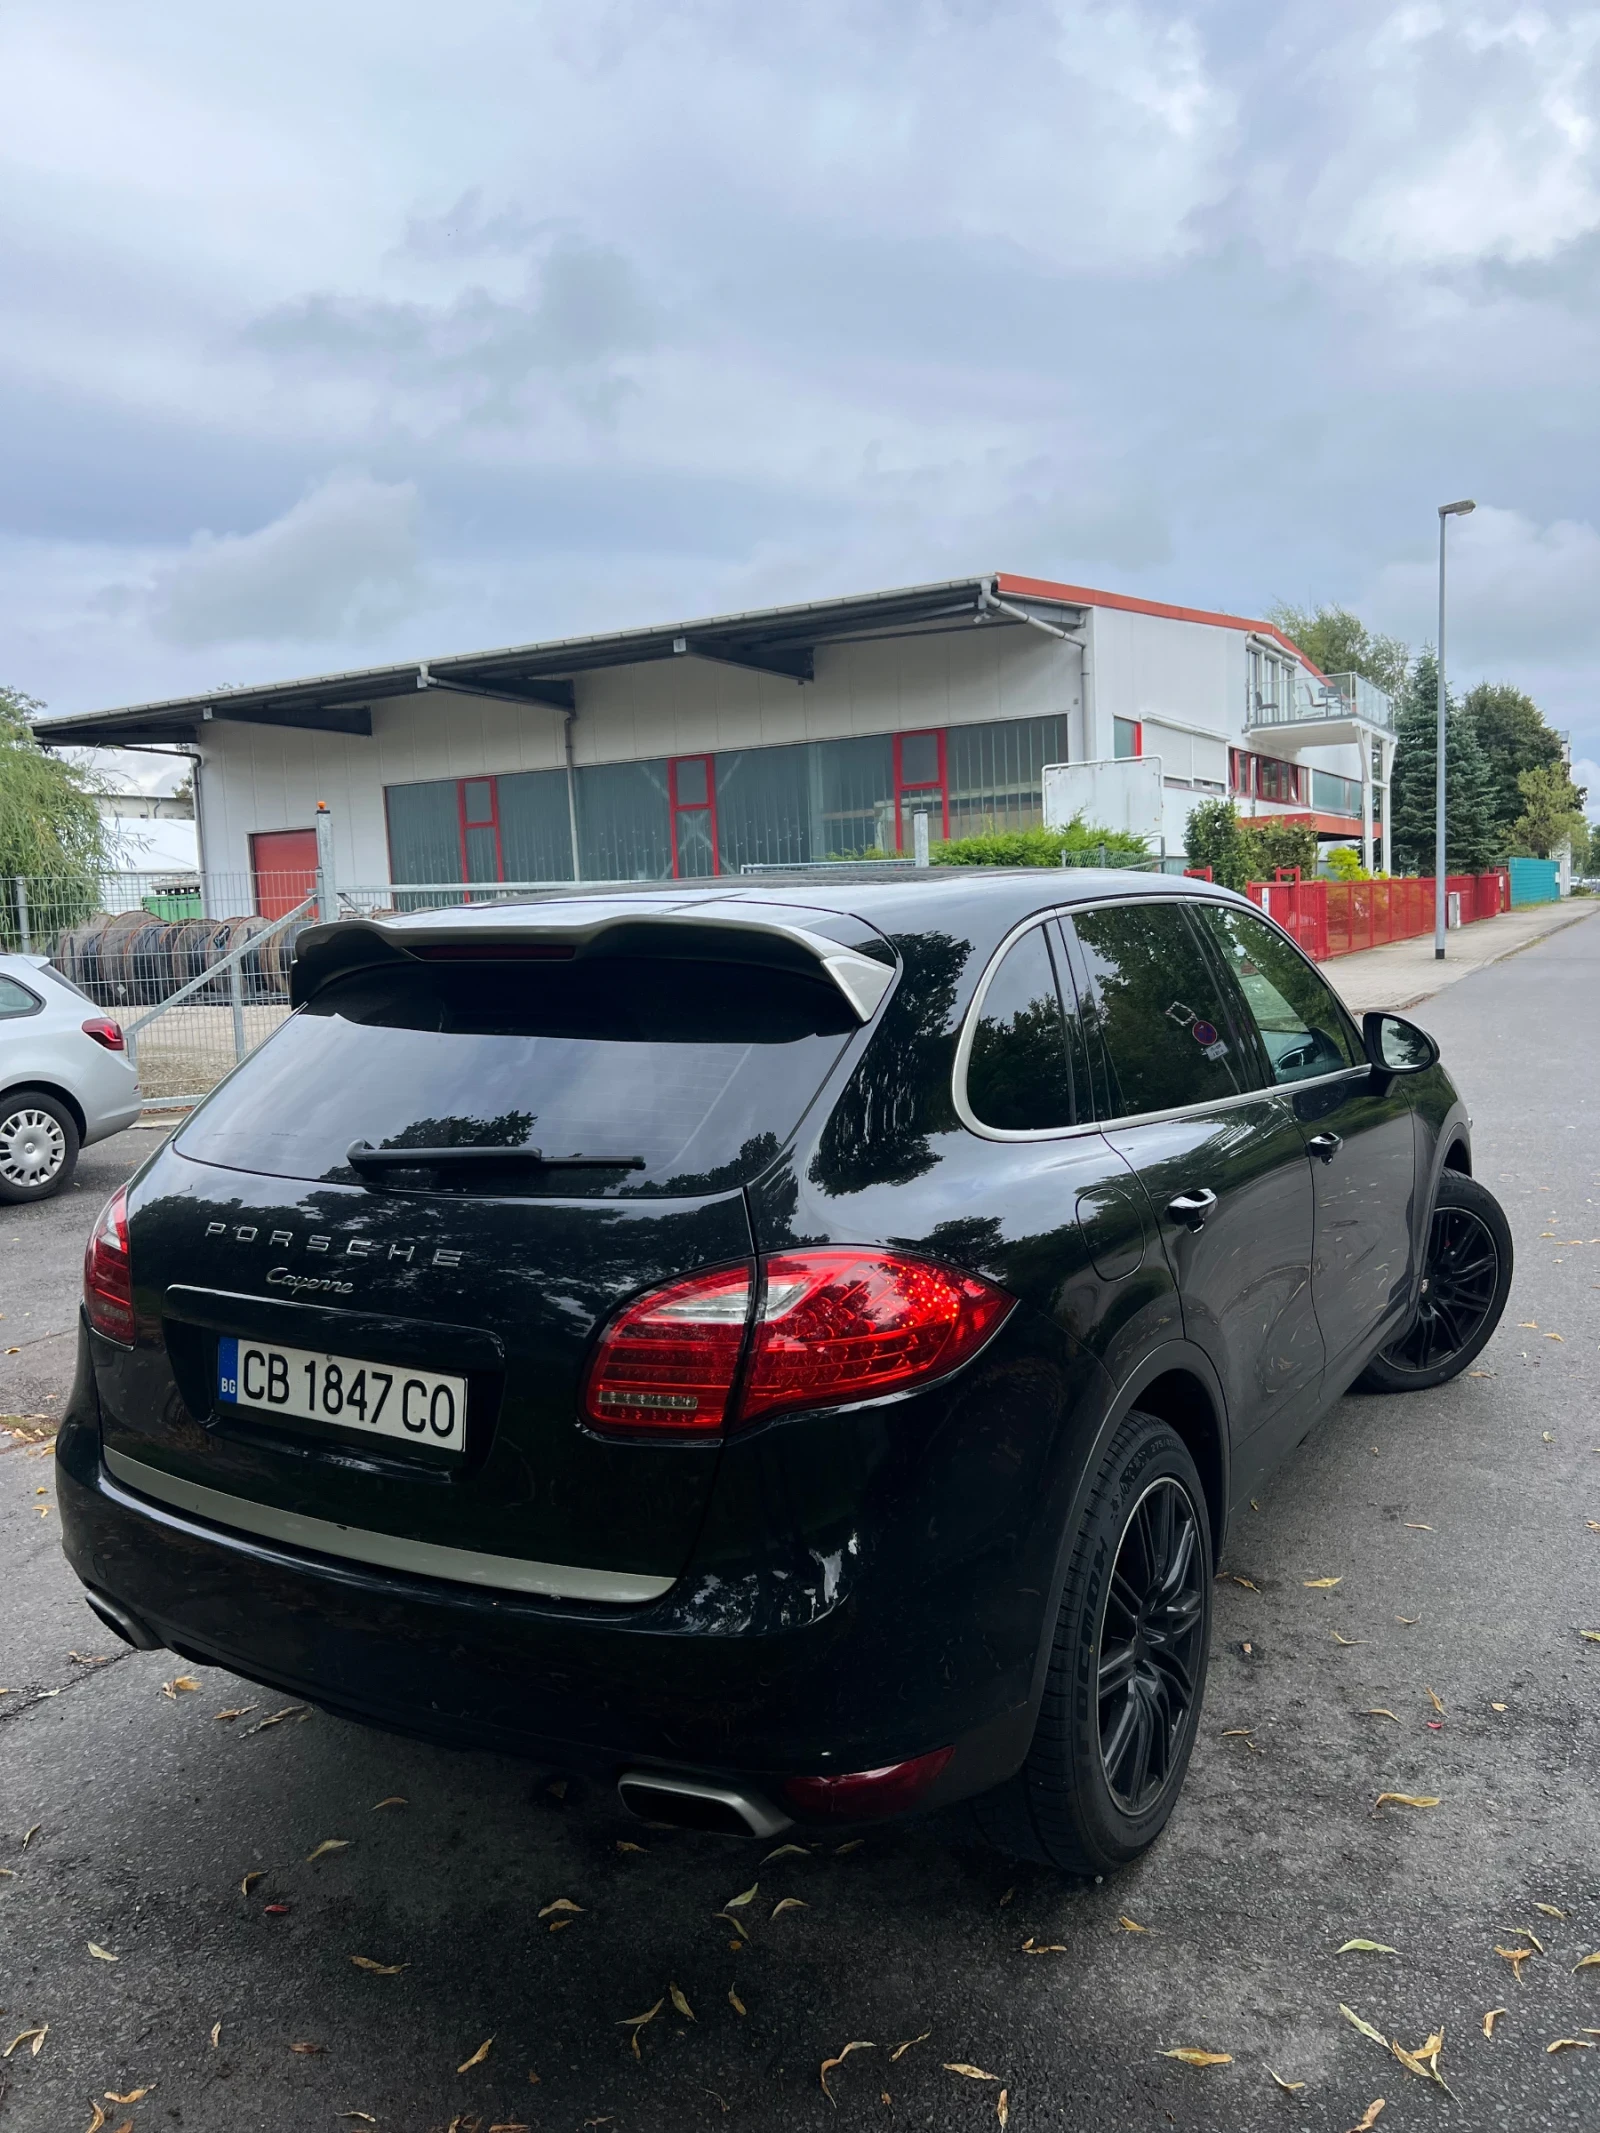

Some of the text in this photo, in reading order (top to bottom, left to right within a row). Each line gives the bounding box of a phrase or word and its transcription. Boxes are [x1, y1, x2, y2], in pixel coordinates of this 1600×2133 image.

[204, 1222, 463, 1267] PORSCHE
[265, 1266, 354, 1295] Cayenne
[220, 1377, 236, 1394] BG
[243, 1350, 290, 1404] CB
[304, 1360, 393, 1424] 1847
